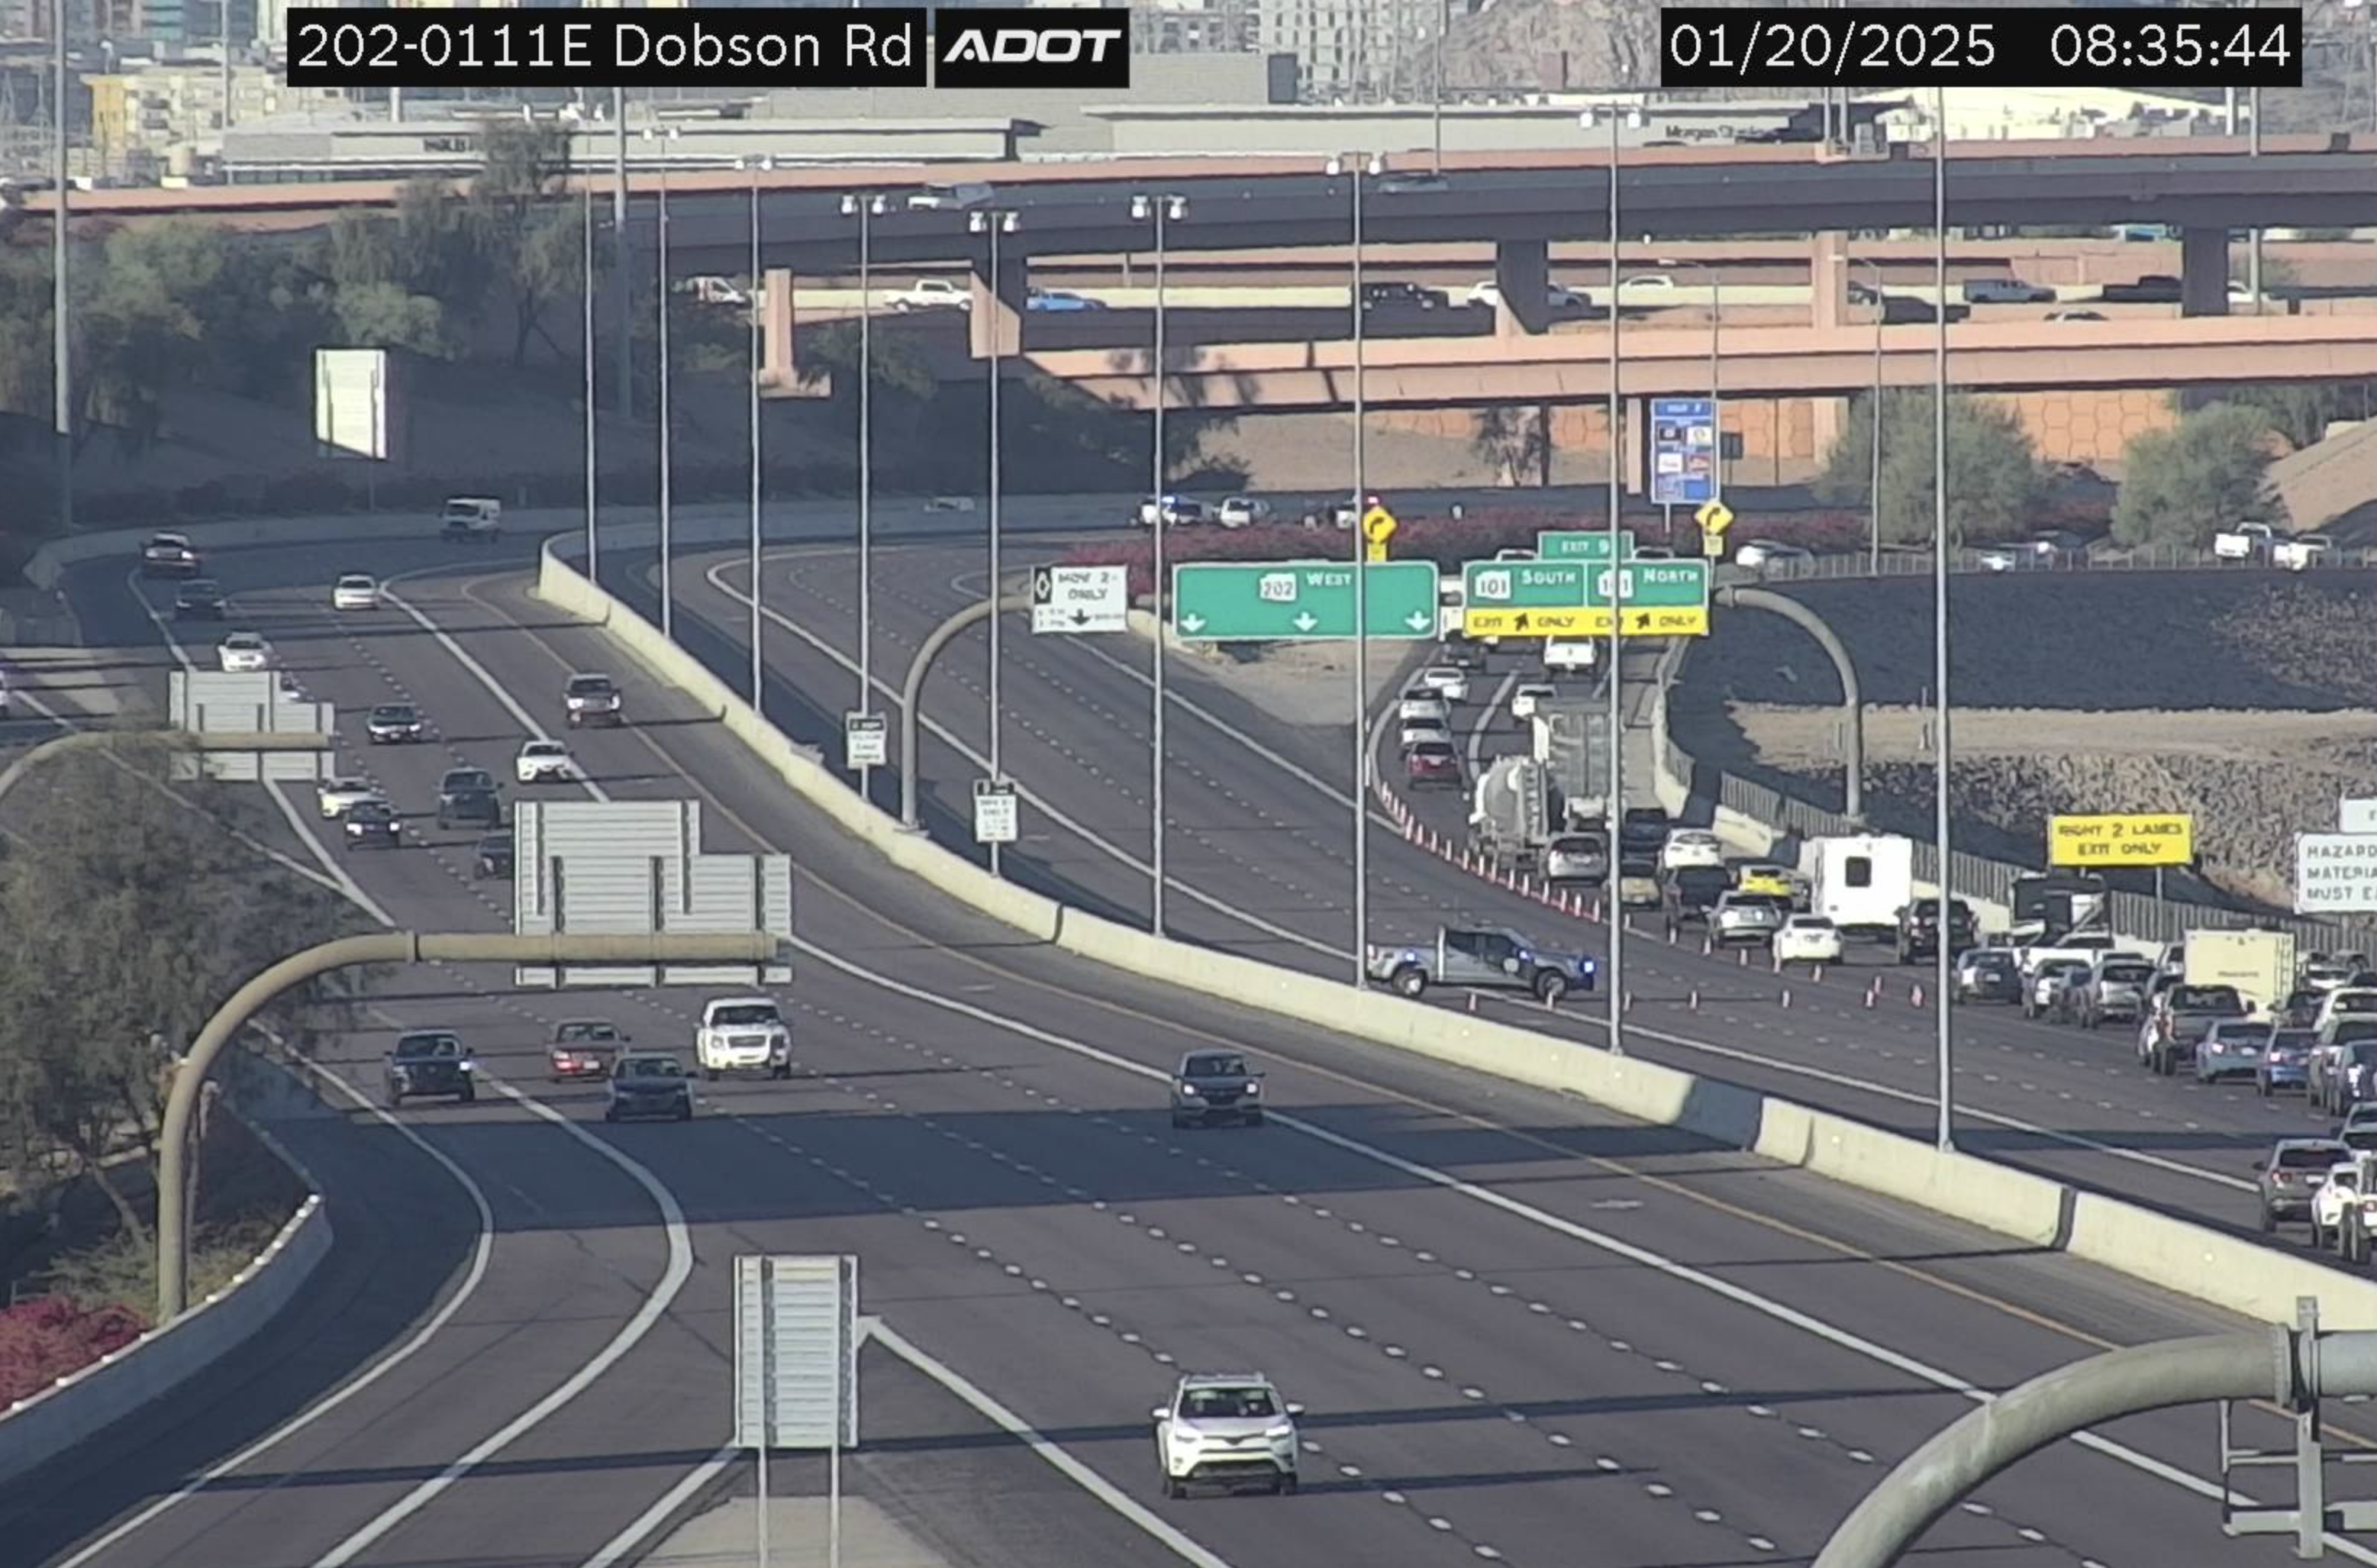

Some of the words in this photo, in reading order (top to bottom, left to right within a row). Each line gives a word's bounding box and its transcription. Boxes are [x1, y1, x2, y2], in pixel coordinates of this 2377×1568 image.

[1562, 540, 1588, 553] EXIT
[1264, 581, 1293, 595] 202
[1306, 572, 1351, 586] WEST
[1481, 579, 1506, 594] 101
[1521, 569, 1576, 586] SOUTH
[1604, 578, 1628, 593] 11
[1643, 568, 1698, 584] NORTH
[1068, 588, 1108, 600] ONLY
[1473, 616, 1502, 628] EXIT
[1537, 615, 1575, 628] ONLY
[1658, 615, 1697, 627] ONLY
[2059, 824, 2101, 837] RIGHT
[2112, 823, 2124, 838] 2
[2132, 824, 2182, 835] LANES
[2078, 843, 2110, 856] EXIT
[2121, 843, 2161, 855] ONLY
[2308, 886, 2353, 900] MUST
